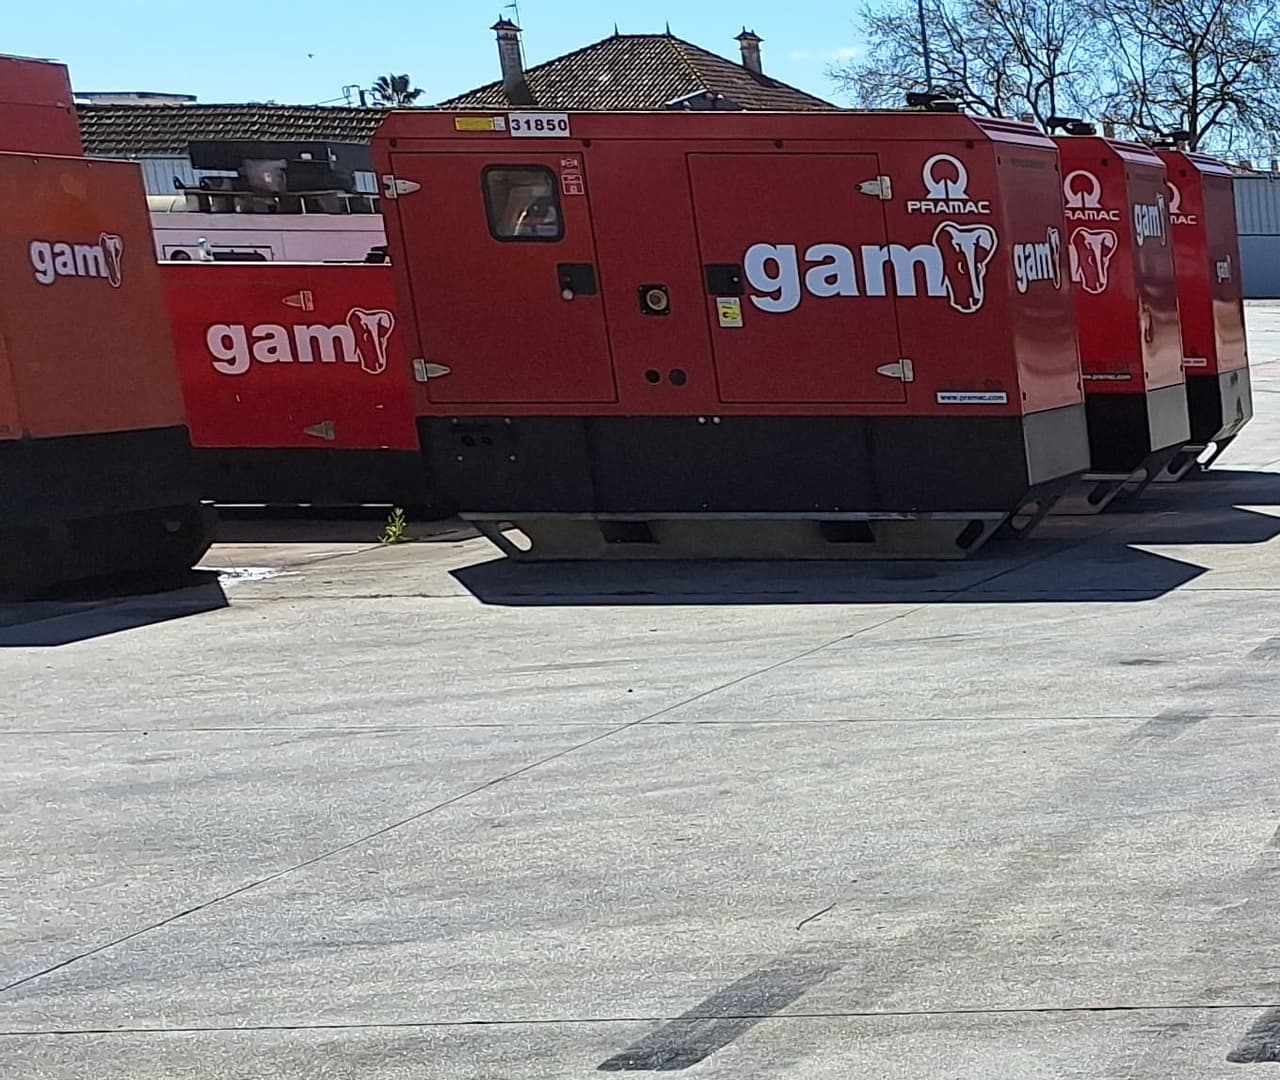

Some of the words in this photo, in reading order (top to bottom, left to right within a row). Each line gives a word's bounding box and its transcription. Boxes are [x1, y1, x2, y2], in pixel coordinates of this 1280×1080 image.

[511, 119, 568, 131] 31850
[907, 201, 991, 214] PRAMAC
[1064, 209, 1120, 220] RAMAC
[1133, 203, 1162, 246] gam
[30, 240, 110, 285] gam
[743, 243, 949, 313] gam
[1013, 241, 1056, 293] gam
[206, 324, 359, 375] gam
